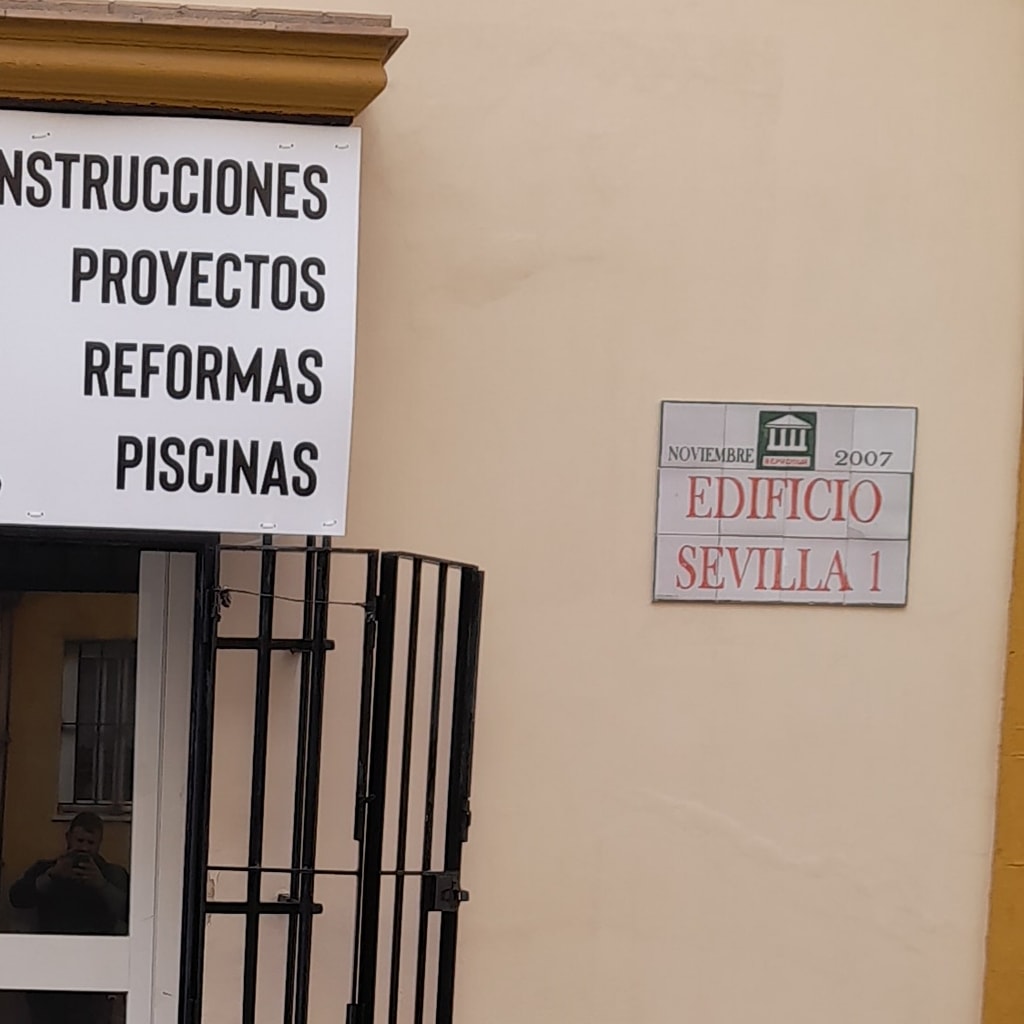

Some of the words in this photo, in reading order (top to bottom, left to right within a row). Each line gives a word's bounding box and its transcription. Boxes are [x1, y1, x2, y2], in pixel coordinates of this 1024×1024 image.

[71, 247, 326, 312] PROYECTOS
[83, 341, 323, 405] REFORMAS
[116, 435, 319, 497] PISCINAS
[668, 446, 754, 464] NOVIEMBRE
[834, 450, 893, 467] 2007
[686, 475, 882, 523] EDIFICIO
[676, 545, 853, 592] SEVILLA
[870, 551, 881, 592] 1
